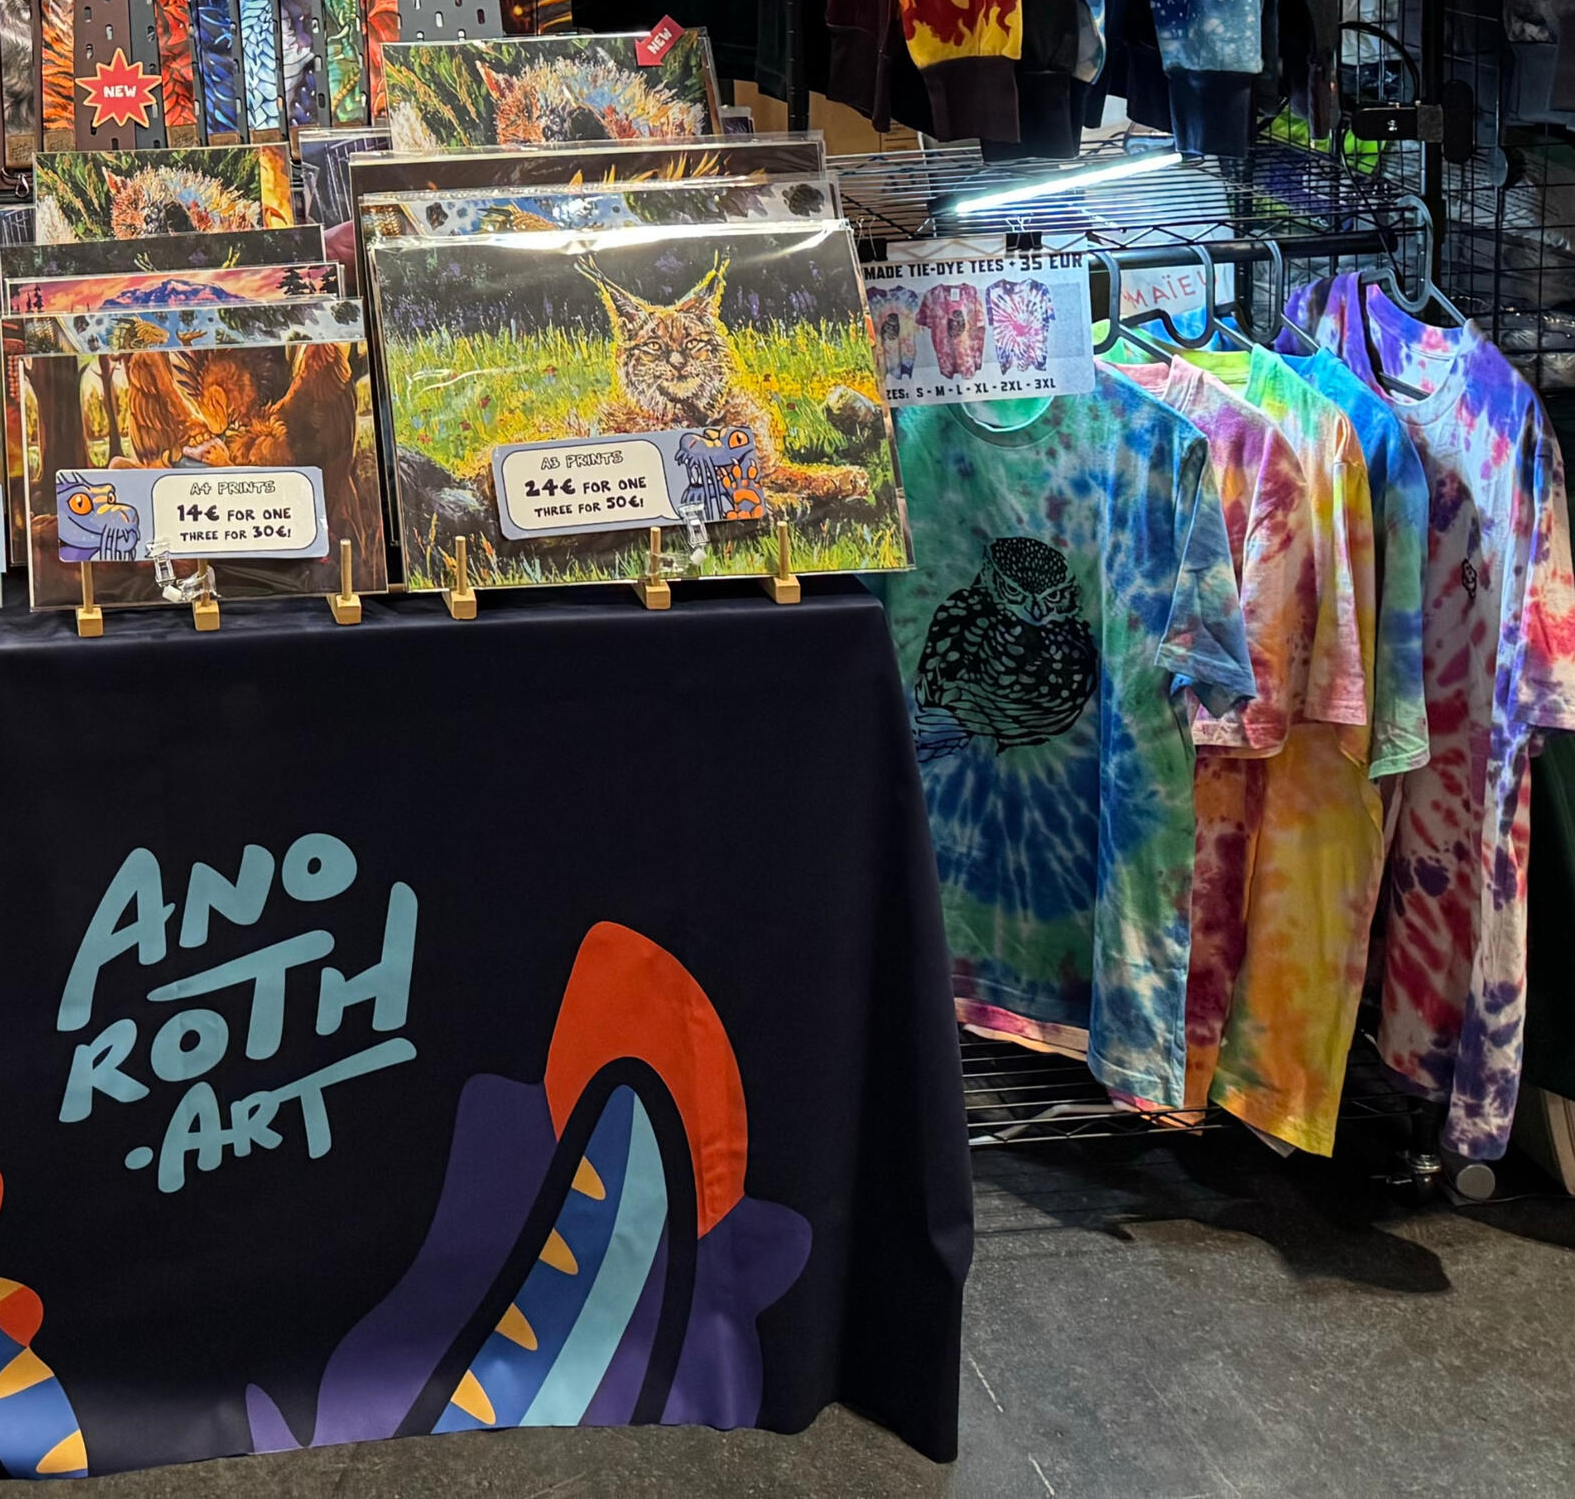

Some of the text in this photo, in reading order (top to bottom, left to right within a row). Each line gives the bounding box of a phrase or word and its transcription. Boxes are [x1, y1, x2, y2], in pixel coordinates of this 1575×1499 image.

[647, 28, 672, 54] NEW
[103, 85, 136, 98] NEW
[907, 260, 965, 278] TIE-DYE
[969, 258, 1005, 274] TEES
[1020, 253, 1043, 271] 35
[1049, 251, 1083, 269] EUR
[917, 387, 924, 398] S
[935, 385, 945, 396] M
[957, 384, 963, 395] L
[975, 382, 989, 394] XL
[1000, 380, 1023, 392] 2XL
[1035, 378, 1056, 390] 3XL
[540, 450, 624, 471] A3 PRINTS
[190, 480, 276, 496] A4 PRINTS
[525, 476, 647, 498] 24€ FOR ONE
[177, 503, 292, 523] 14€ FOR ONE
[534, 495, 645, 518] THREE FOR 50€!
[179, 525, 292, 542] THREE FOR 30€!
[56, 833, 358, 1032] ANO
[59, 881, 419, 1123] ROTH
[124, 1037, 418, 1194] .ART
